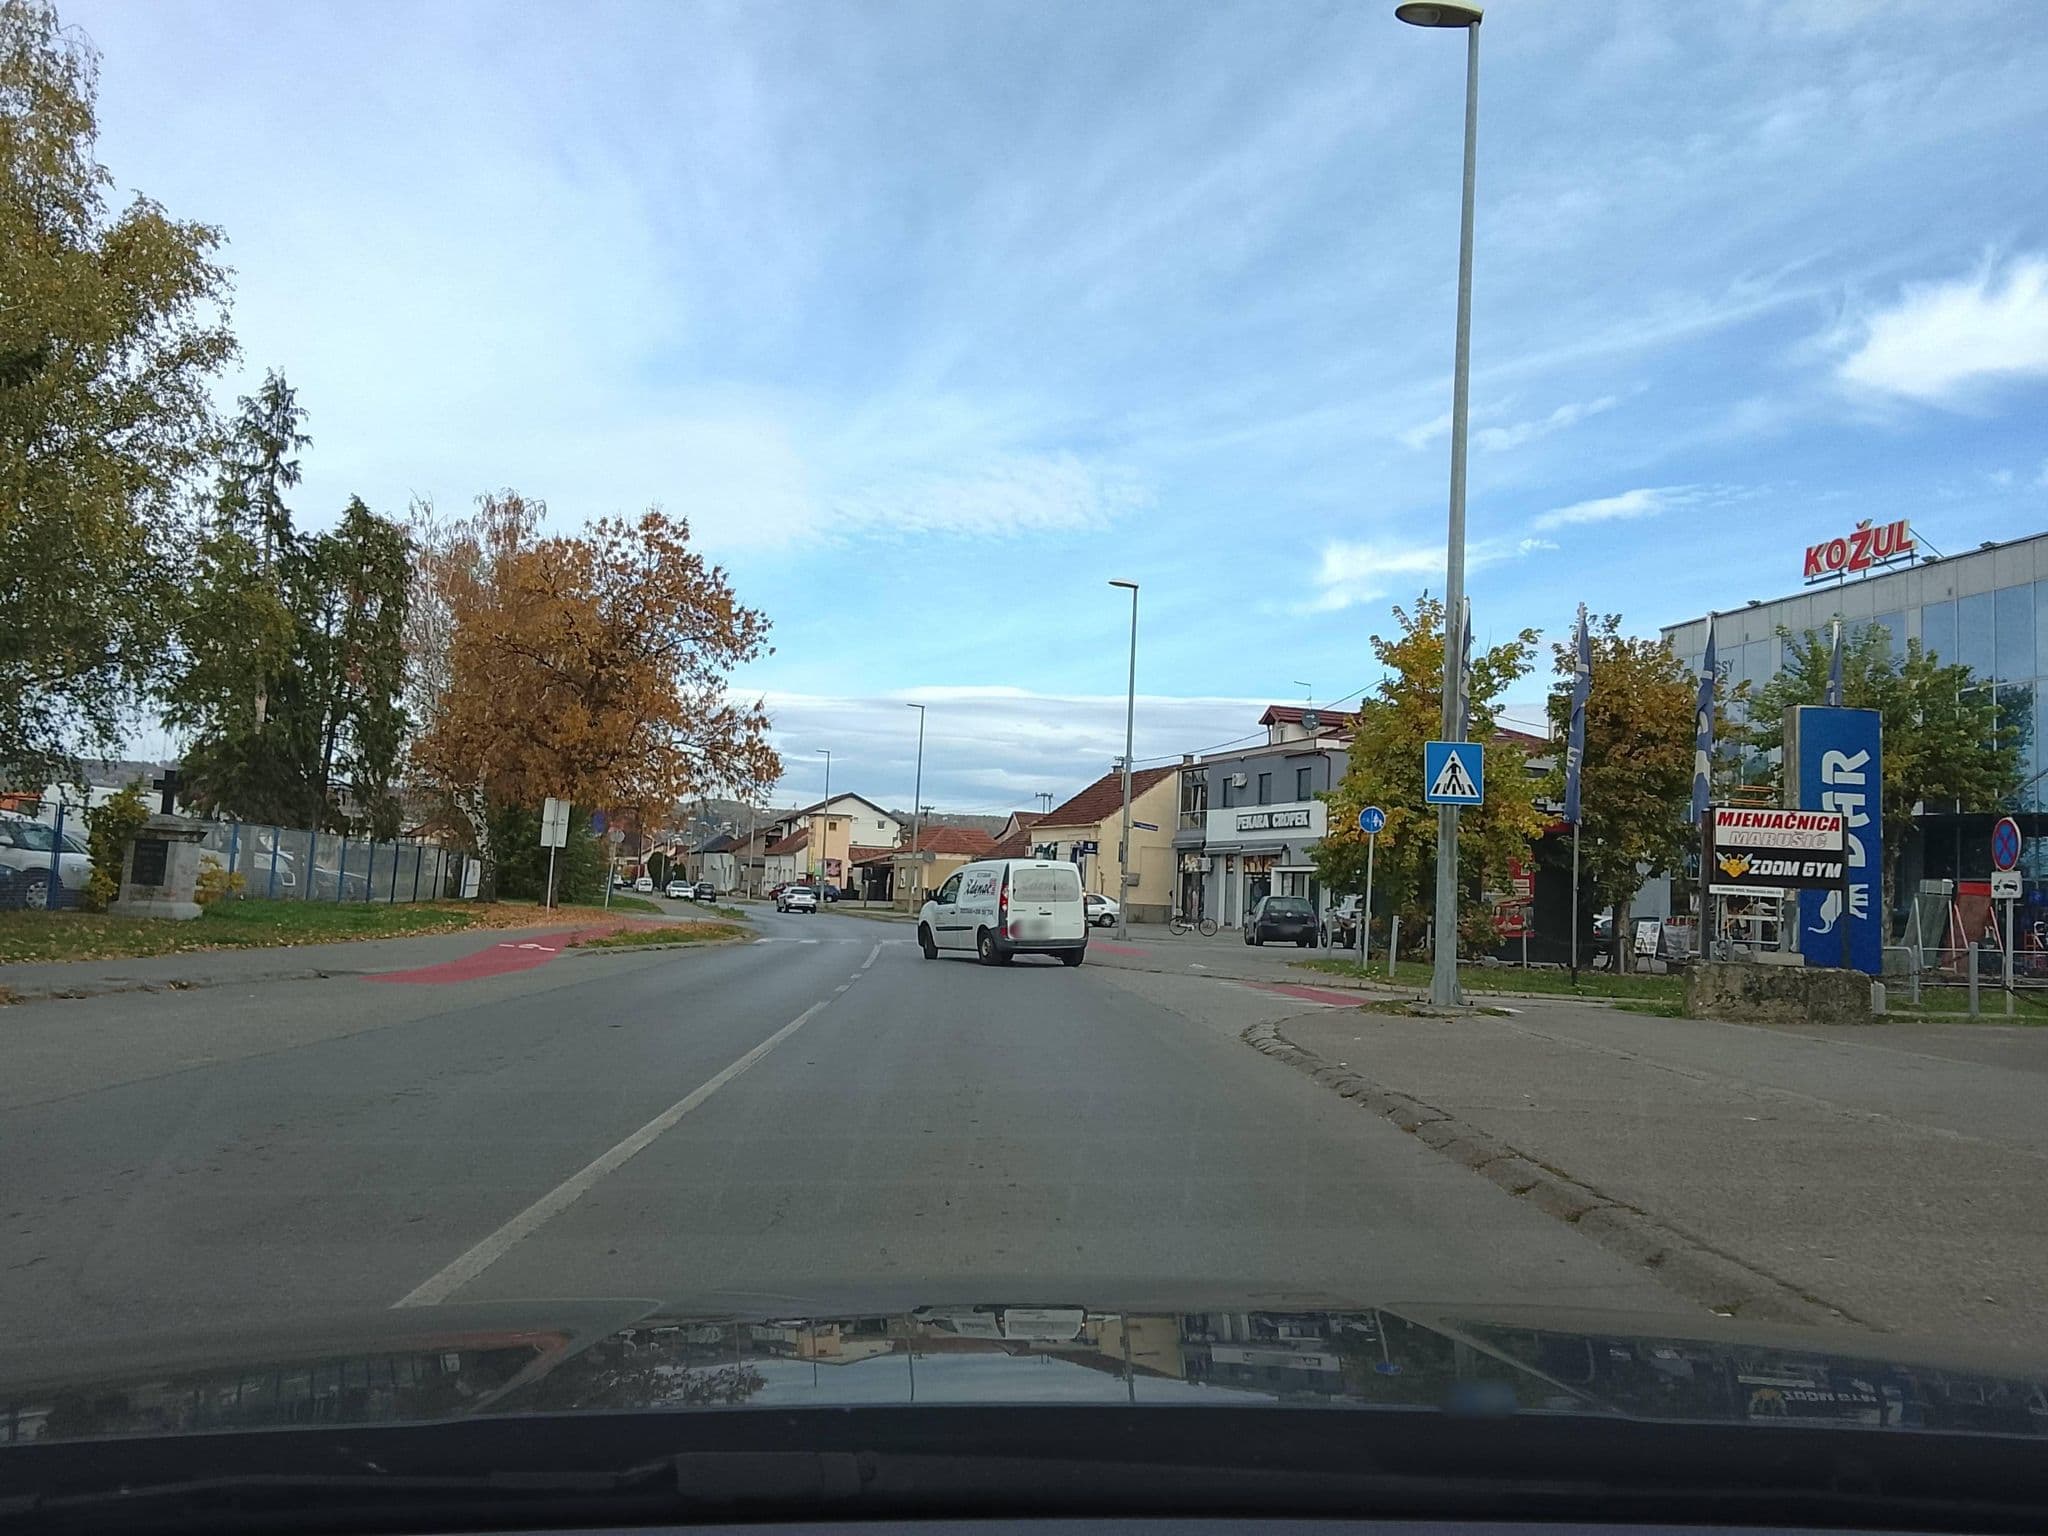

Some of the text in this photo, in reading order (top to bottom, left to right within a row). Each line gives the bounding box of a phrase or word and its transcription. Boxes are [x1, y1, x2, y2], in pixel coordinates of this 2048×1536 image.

[1804, 518, 1916, 576] KOŽUL
[1717, 811, 1840, 831] MJENJAČNICA
[1749, 859, 1842, 878] ZOOM GYM
